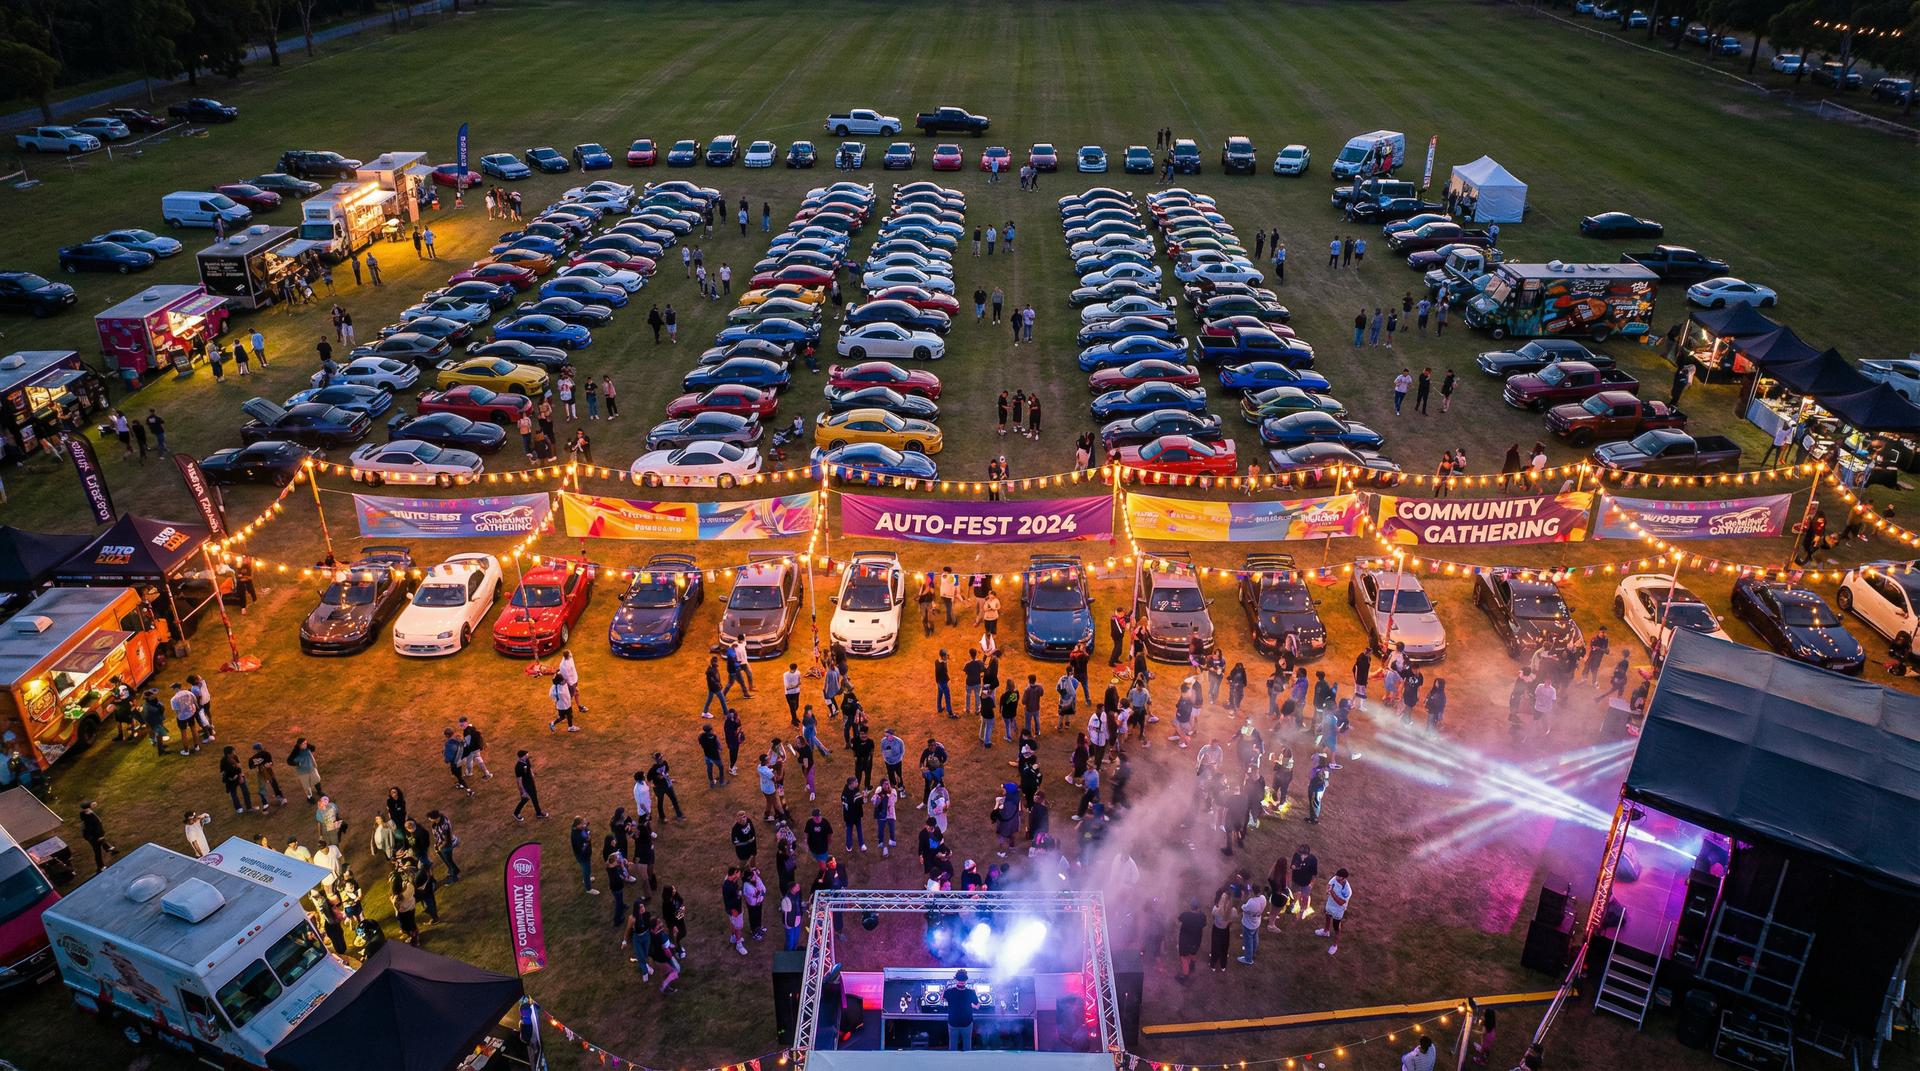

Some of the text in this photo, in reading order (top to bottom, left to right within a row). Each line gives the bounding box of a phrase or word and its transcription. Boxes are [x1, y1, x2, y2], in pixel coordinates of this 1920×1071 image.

[1398, 498, 1544, 521] COMMUNITY
[875, 512, 1077, 535] AUTO-FEST 2024
[1424, 518, 1560, 543] GATHERING
[513, 885, 527, 946] COMMUNITY
